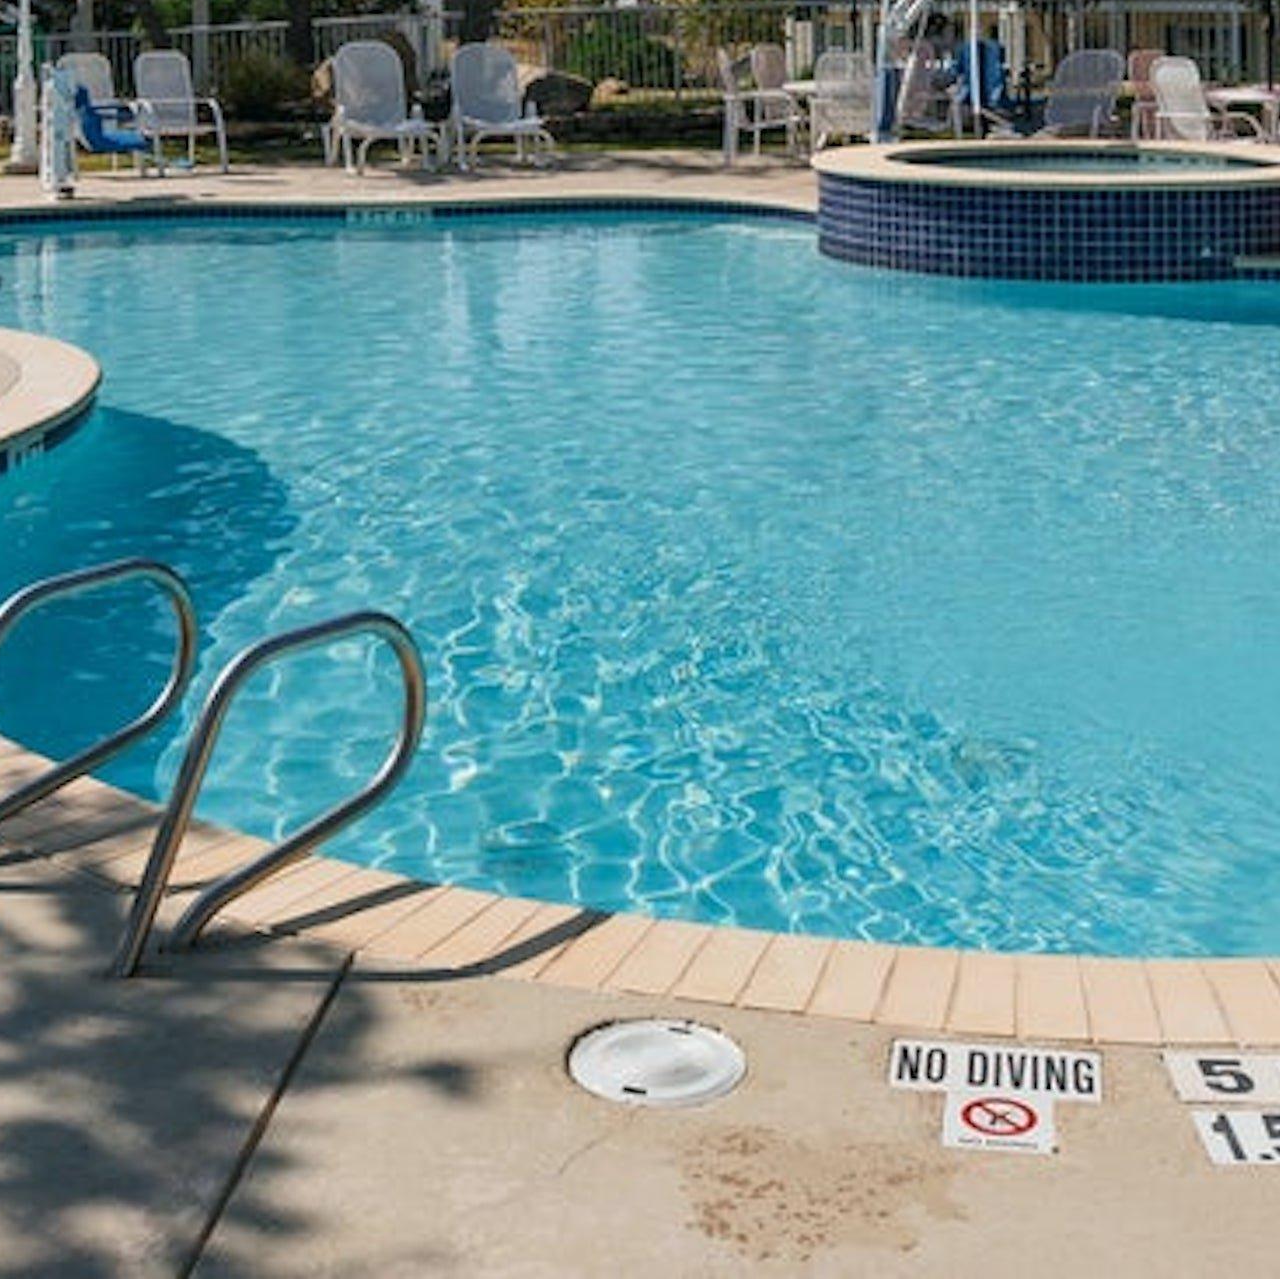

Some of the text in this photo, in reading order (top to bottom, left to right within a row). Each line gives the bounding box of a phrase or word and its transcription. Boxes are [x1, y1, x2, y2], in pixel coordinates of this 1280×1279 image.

[897, 1045, 1095, 1094] NO DIVING
[1197, 1059, 1255, 1094] 5
